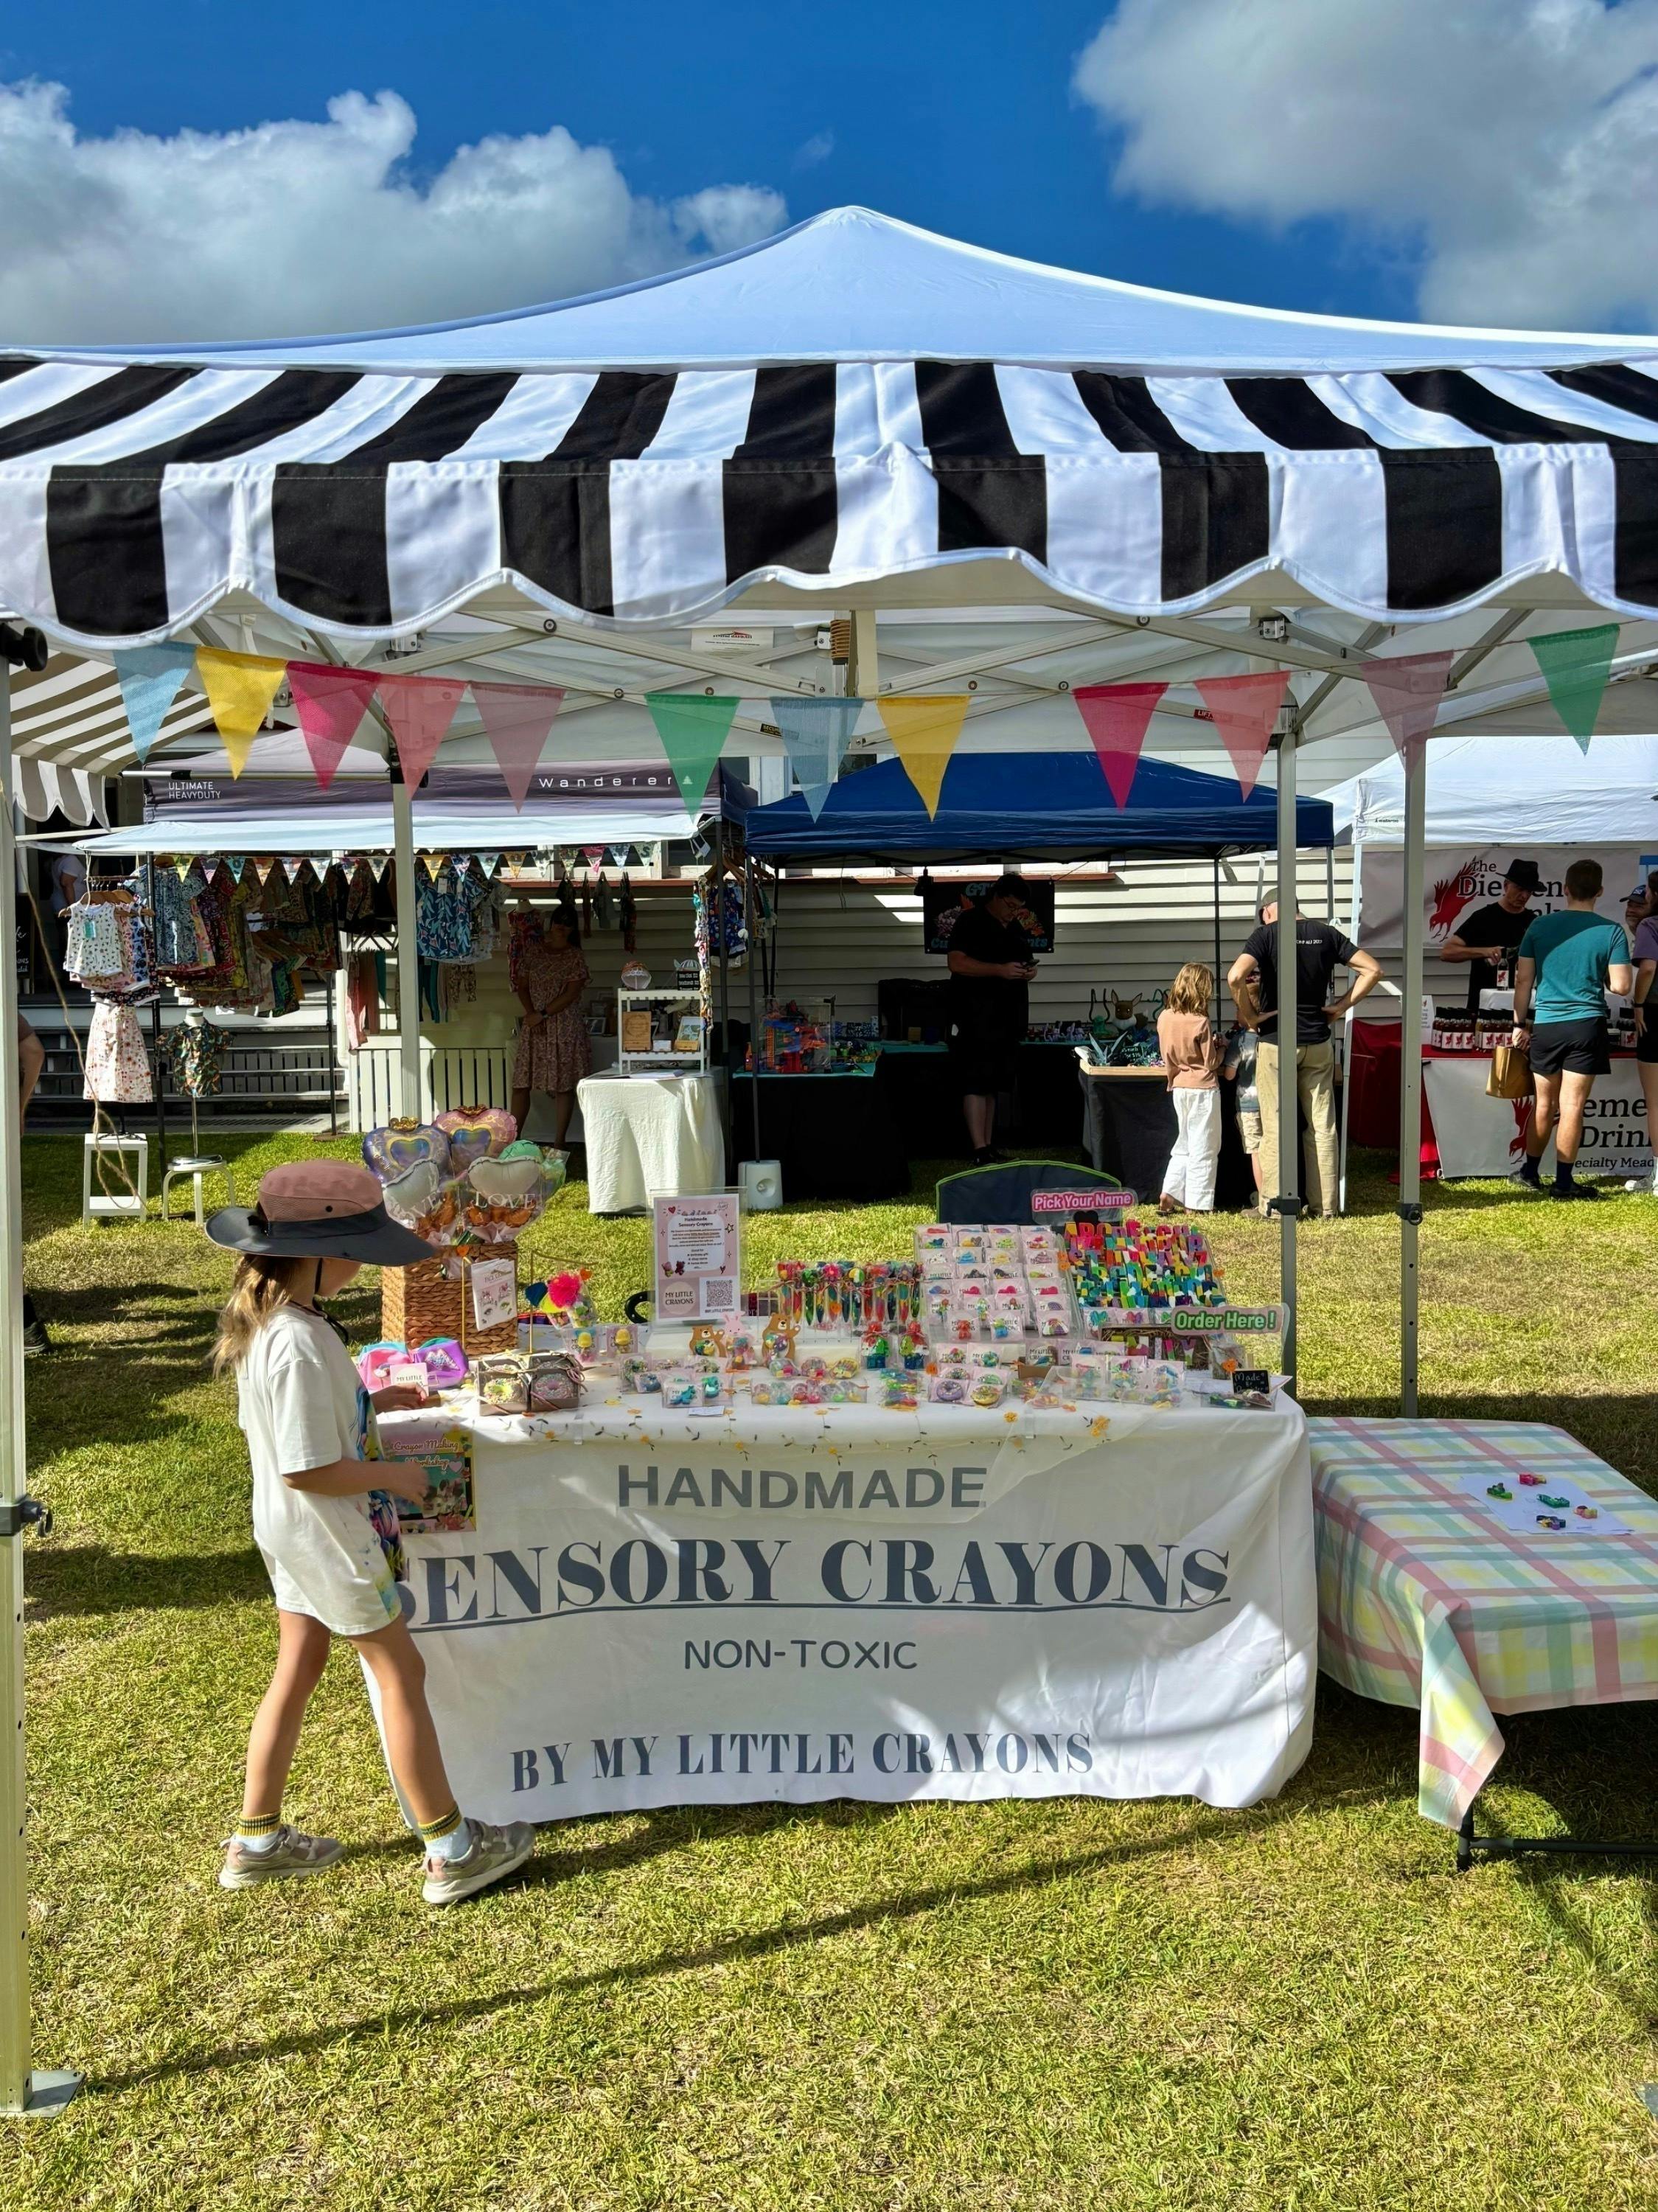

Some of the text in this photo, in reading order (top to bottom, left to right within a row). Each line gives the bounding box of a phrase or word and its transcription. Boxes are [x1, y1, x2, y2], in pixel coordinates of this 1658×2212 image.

[168, 781, 214, 790] ULTIMATE
[539, 776, 672, 787] Wanderer
[169, 790, 221, 799] HEAVYDUTY
[1472, 860, 1497, 872] The
[1457, 874, 1564, 897] Dieen
[1578, 1123, 1653, 1148] Drin
[1575, 1157, 1617, 1171] ecialty
[475, 1192, 537, 1209] LOVE
[1034, 1192, 1132, 1210] Pick Your Name
[1176, 1311, 1222, 1328] Order
[1226, 1311, 1265, 1328] Here
[394, 1438, 460, 1454] Crayon Making
[618, 1464, 987, 1509] HANDMADE
[821, 1539, 1230, 1607] CRAYONS
[685, 1639, 918, 1669] NON-TOXIC
[510, 1733, 1093, 1792] BY MY LITTLE CRAYONS
